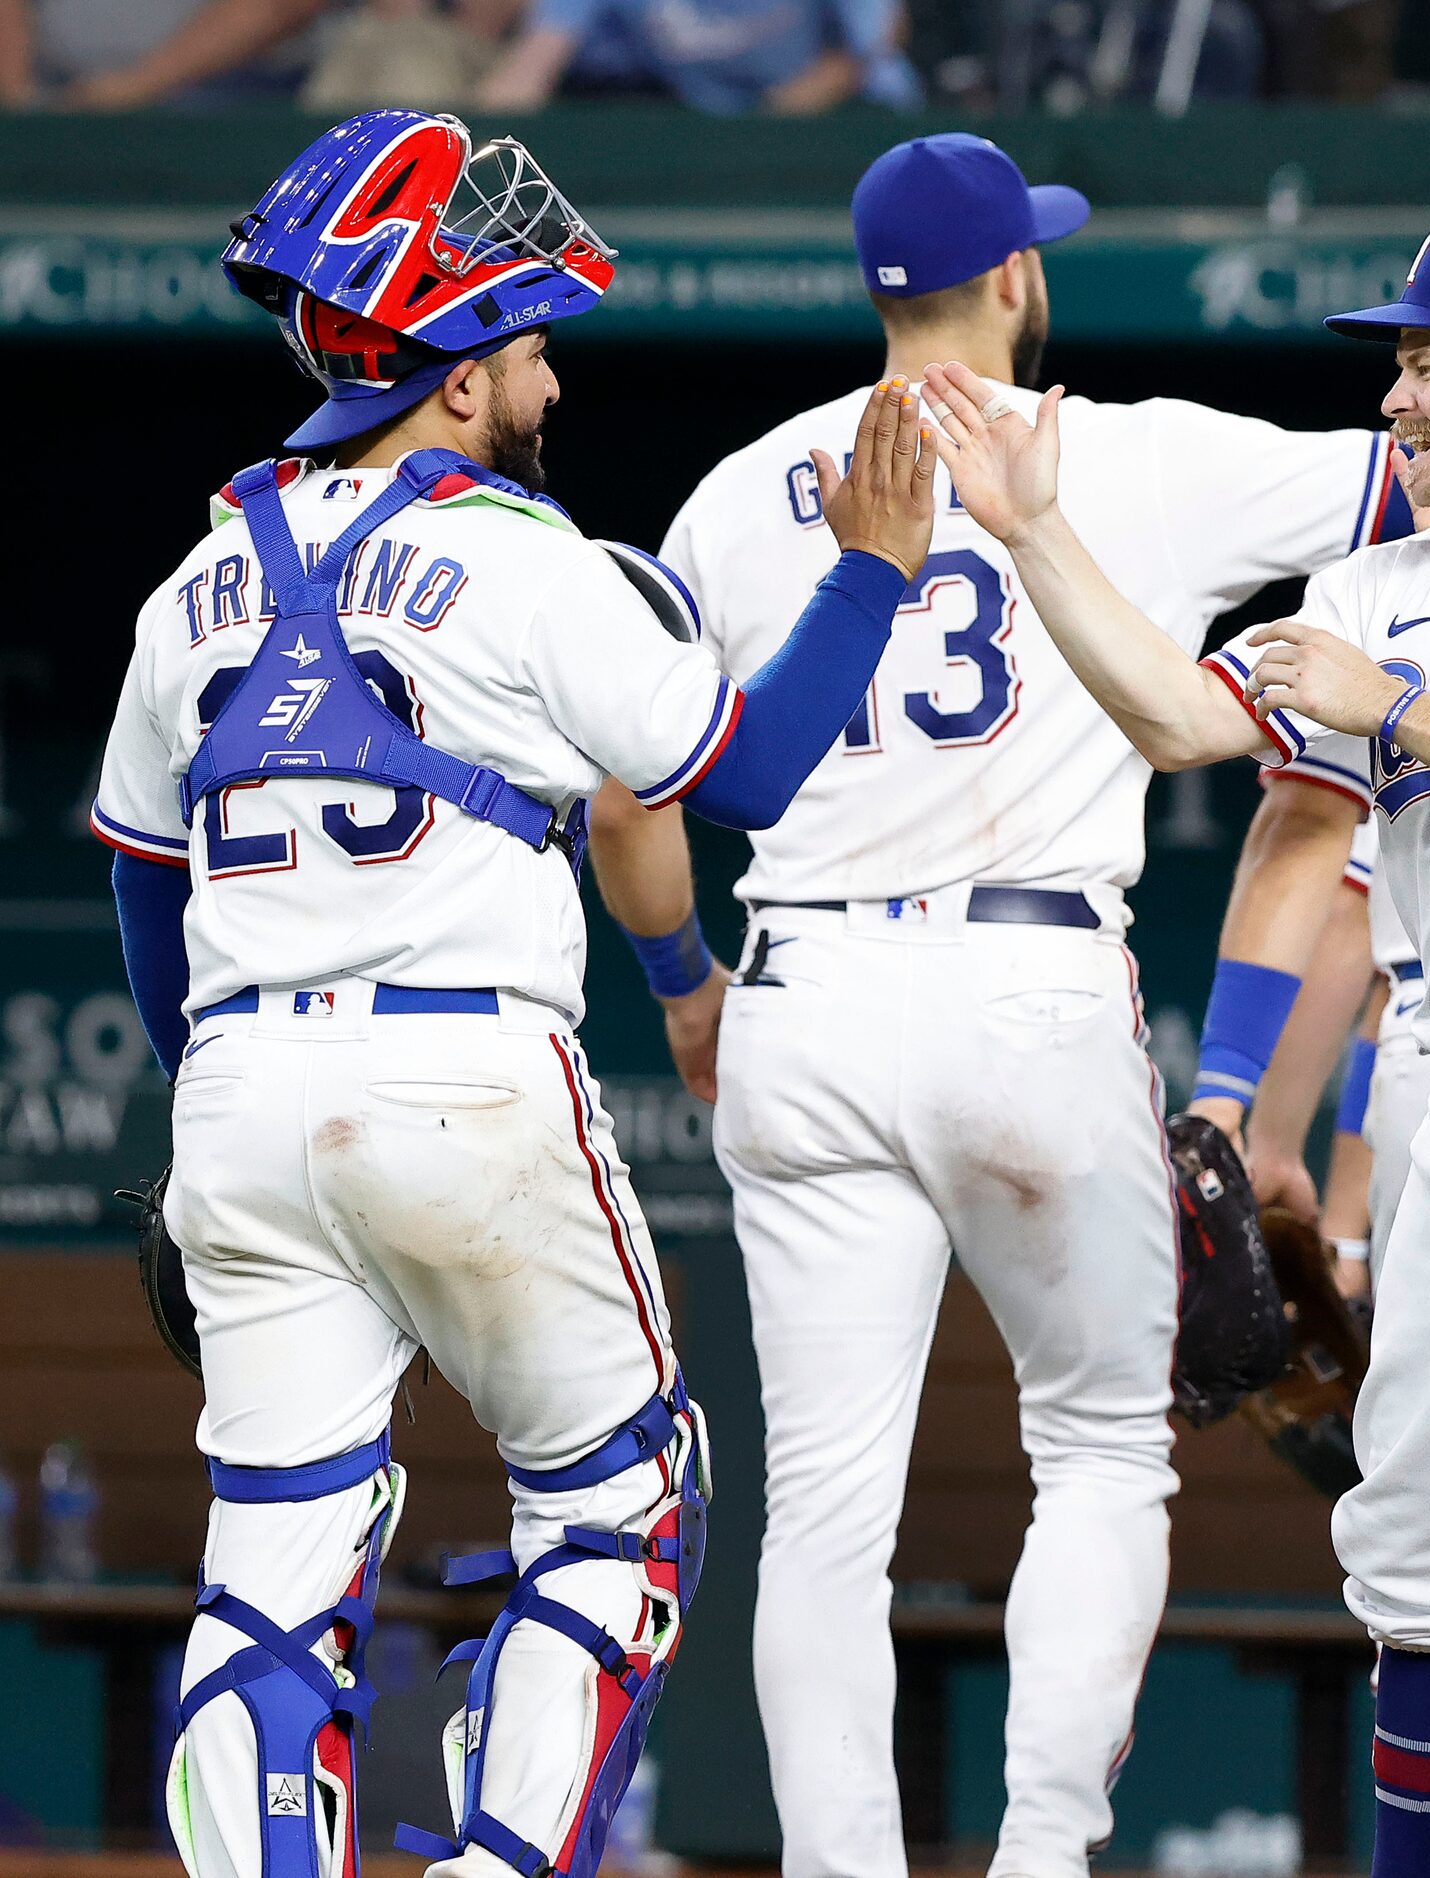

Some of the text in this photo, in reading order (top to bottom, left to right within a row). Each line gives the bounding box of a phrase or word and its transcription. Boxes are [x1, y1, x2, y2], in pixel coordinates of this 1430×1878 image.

[500, 300, 552, 330] ALL-STAR
[177, 538, 469, 649] TRINO
[815, 548, 1023, 756] 3
